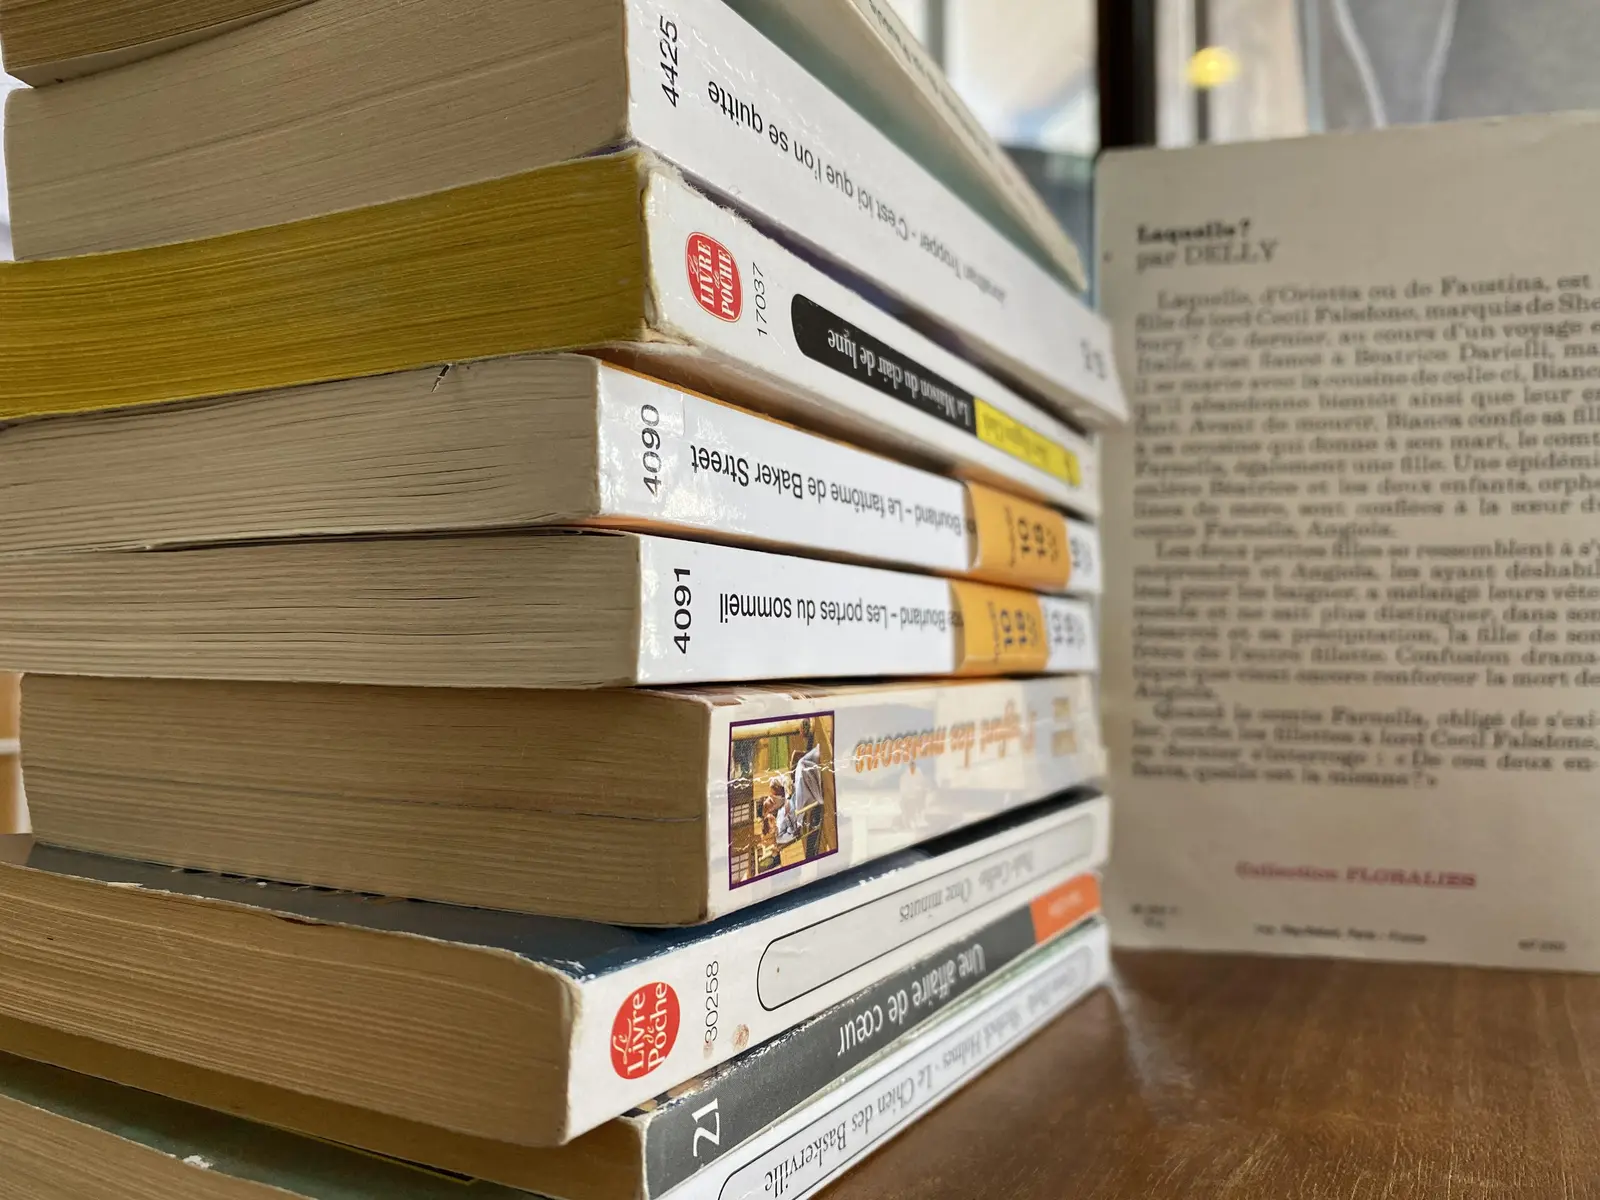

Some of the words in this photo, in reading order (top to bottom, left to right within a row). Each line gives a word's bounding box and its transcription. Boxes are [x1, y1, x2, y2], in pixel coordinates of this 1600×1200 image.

[660, 16, 680, 108] 4425
[708, 80, 763, 134] quitte
[768, 124, 789, 152] se
[794, 140, 822, 182] l'on
[826, 165, 853, 197] que
[858, 187, 874, 218] ici
[876, 200, 908, 241] C'est
[920, 230, 962, 280] Tropper
[1185, 237, 1279, 266] DELLY
[698, 240, 716, 308] LIVRE
[718, 249, 736, 318] POCHE
[1404, 277, 1433, 298] de
[1440, 272, 1551, 298] Faustina,
[1557, 271, 1592, 290] est
[752, 262, 768, 338] 17037
[1425, 296, 1522, 322] marquis
[1526, 293, 1554, 314] de
[1443, 317, 1496, 339] d'un
[1502, 317, 1582, 340] voyage
[828, 330, 858, 368] lune
[860, 346, 876, 376] de
[878, 357, 904, 390] clair
[904, 370, 918, 398] du
[1412, 364, 1439, 384] de
[920, 379, 958, 418] Maison
[1409, 389, 1463, 408] ainsi
[1471, 391, 1516, 410] que
[1524, 384, 1572, 404] leur
[1387, 410, 1462, 430] Bianca
[1468, 408, 1537, 428] confie
[1542, 413, 1565, 427] sa
[640, 404, 662, 498] 4090
[1405, 435, 1443, 450] son
[1451, 430, 1511, 451] mari,
[1519, 428, 1538, 447] le
[690, 444, 749, 487] Street
[1454, 451, 1501, 471] Une
[754, 462, 803, 500] Baker
[808, 476, 826, 504] de
[830, 482, 886, 518] fantôme
[888, 498, 902, 522] Le
[1480, 496, 1500, 515] la
[914, 504, 962, 536] Bourland
[1430, 561, 1496, 583] ayant
[1489, 581, 1546, 600] leurs
[674, 568, 692, 654] 4091
[720, 593, 792, 624] sommeil
[797, 598, 816, 626] du
[820, 598, 862, 626] portes
[866, 604, 888, 629] Les
[900, 606, 946, 632] Bourland
[1503, 603, 1557, 622] dans
[1478, 624, 1520, 643] fille
[1529, 624, 1557, 643] de
[855, 730, 946, 775] moissons
[1346, 866, 1477, 890] FLORALIES
[900, 889, 944, 922] minutes
[958, 944, 986, 978] Une
[912, 961, 957, 1006] affaire
[704, 960, 720, 1044] 30258
[888, 989, 908, 1029] de
[612, 1018, 631, 1065] Le
[627, 992, 646, 1075] Livre
[644, 1027, 654, 1044] de
[648, 982, 668, 1070] Poche
[838, 1010, 883, 1056] cœur
[916, 1065, 933, 1090] Le
[877, 1079, 916, 1119] Chien
[692, 1098, 720, 1157] 21
[850, 1104, 874, 1135] des
[764, 1120, 848, 1198] Baskerville
